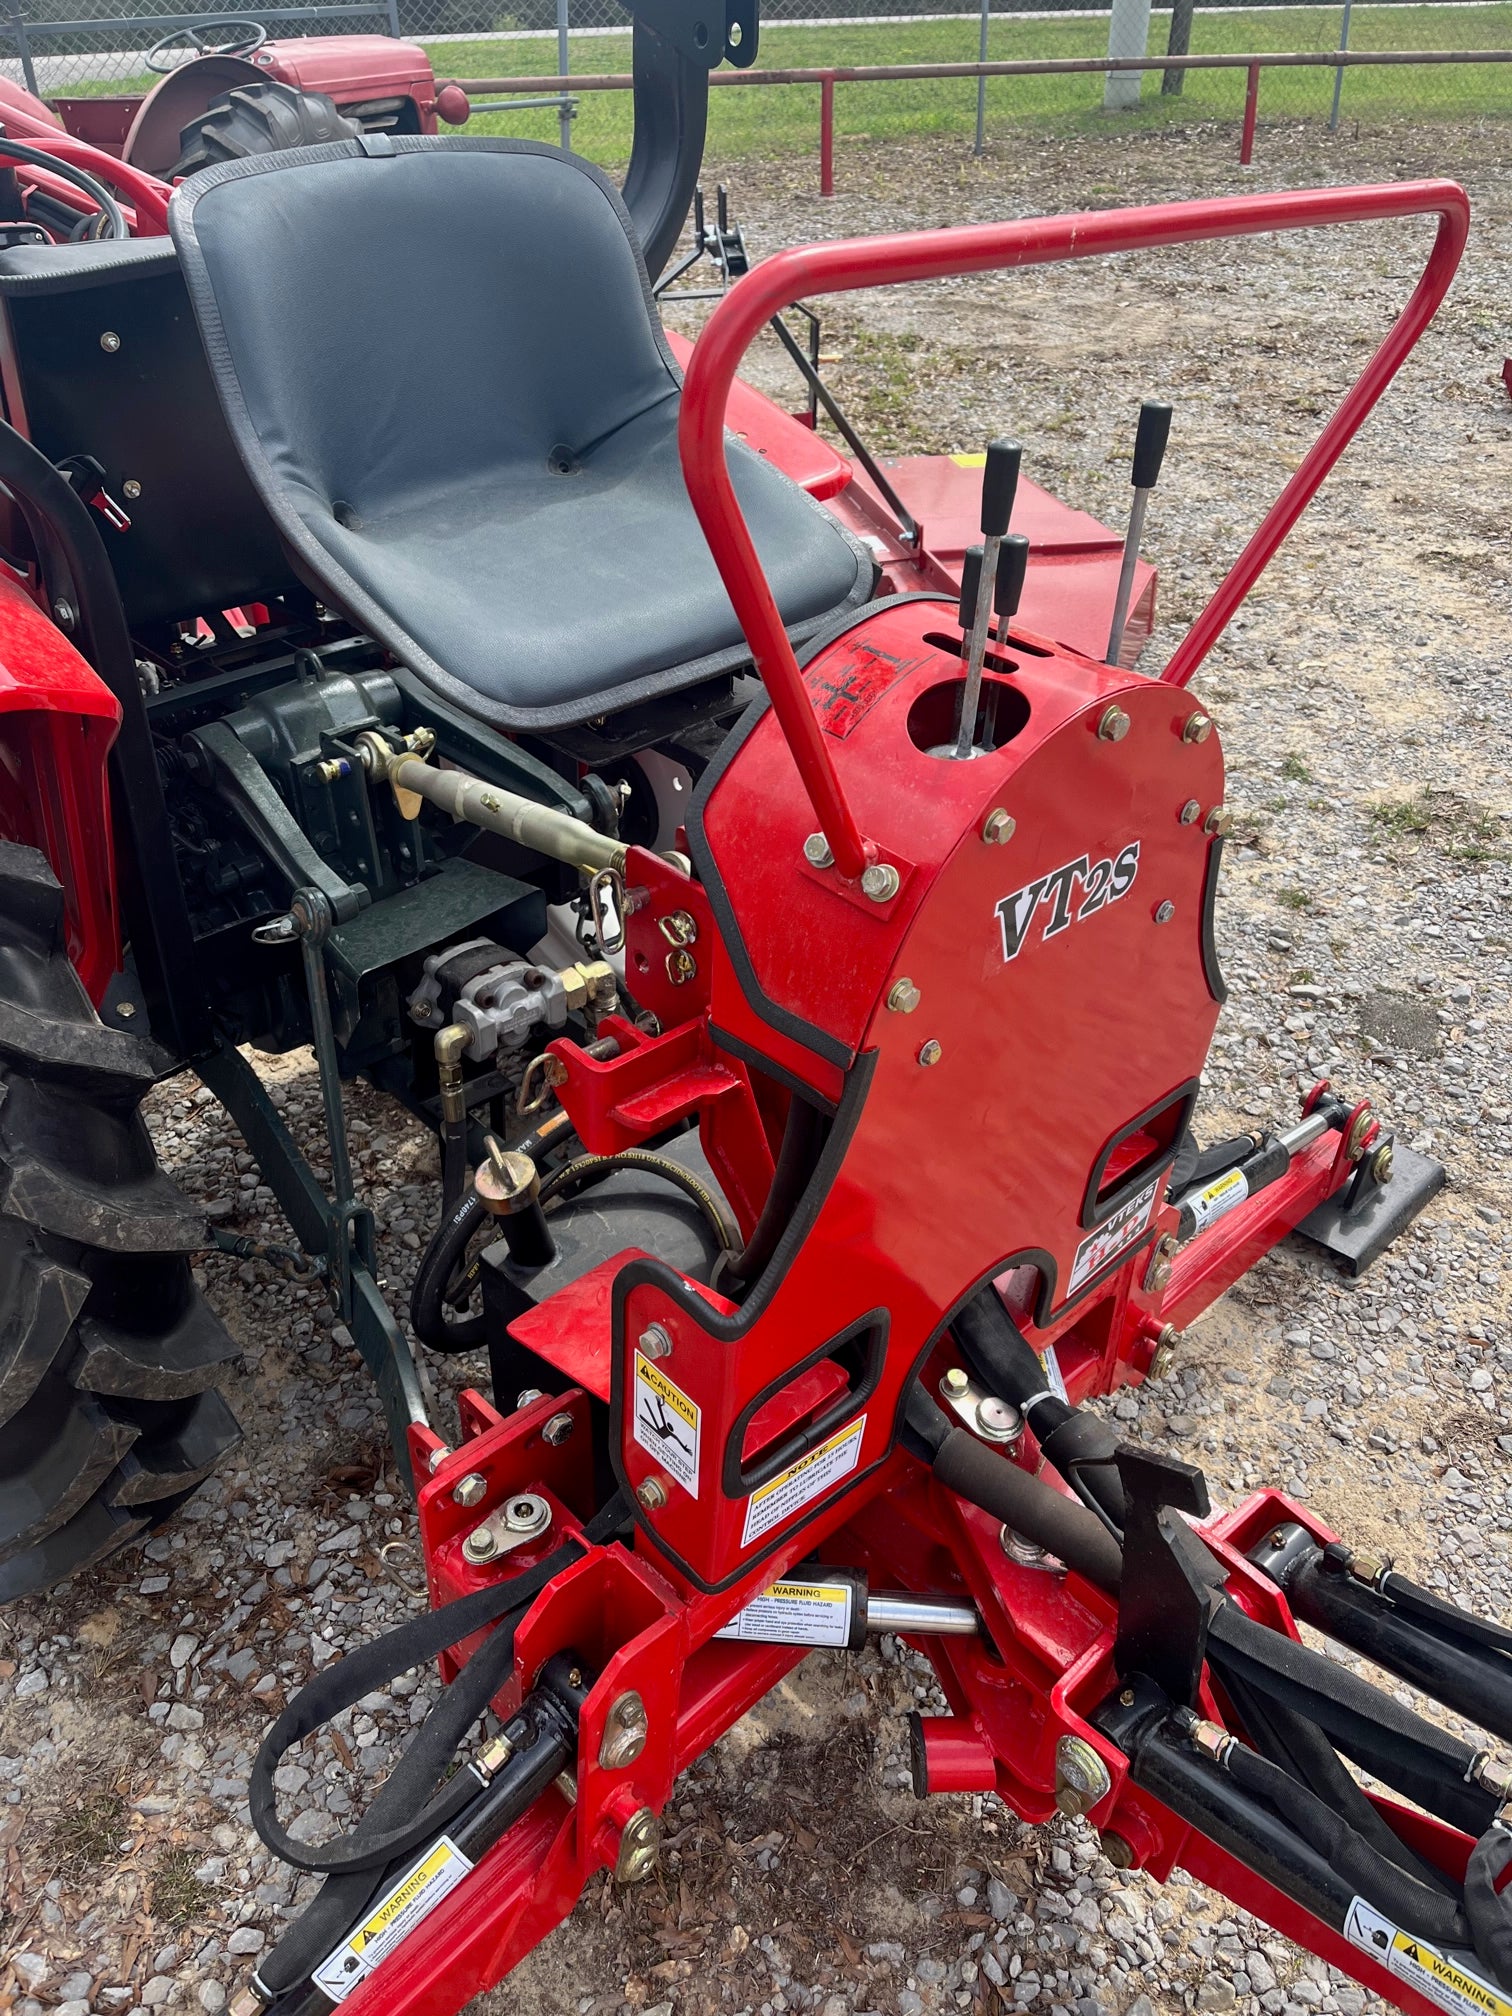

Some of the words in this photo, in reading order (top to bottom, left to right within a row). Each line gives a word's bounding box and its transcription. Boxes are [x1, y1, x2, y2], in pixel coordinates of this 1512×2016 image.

[995, 840, 1140, 962] VT2S
[661, 1160, 702, 1192] TECHNOLOGY
[452, 1196, 476, 1224] 1740PSI
[1107, 1184, 1154, 1232] VTEKS
[650, 1374, 694, 1421] CAUTION
[787, 1445, 829, 1478] NOTE
[772, 1586, 821, 1598] WARNING
[375, 1929, 387, 1943] HIGH
[390, 1902, 413, 1926] PRESSURE
[413, 1889, 426, 1903] FLUID
[426, 1868, 445, 1889] HAZARD
[380, 1871, 428, 1922] WARNING
[1409, 1960, 1426, 1975] HIGH
[1431, 1975, 1463, 2001] PRESSURE
[1462, 1997, 1481, 2013] FLUID
